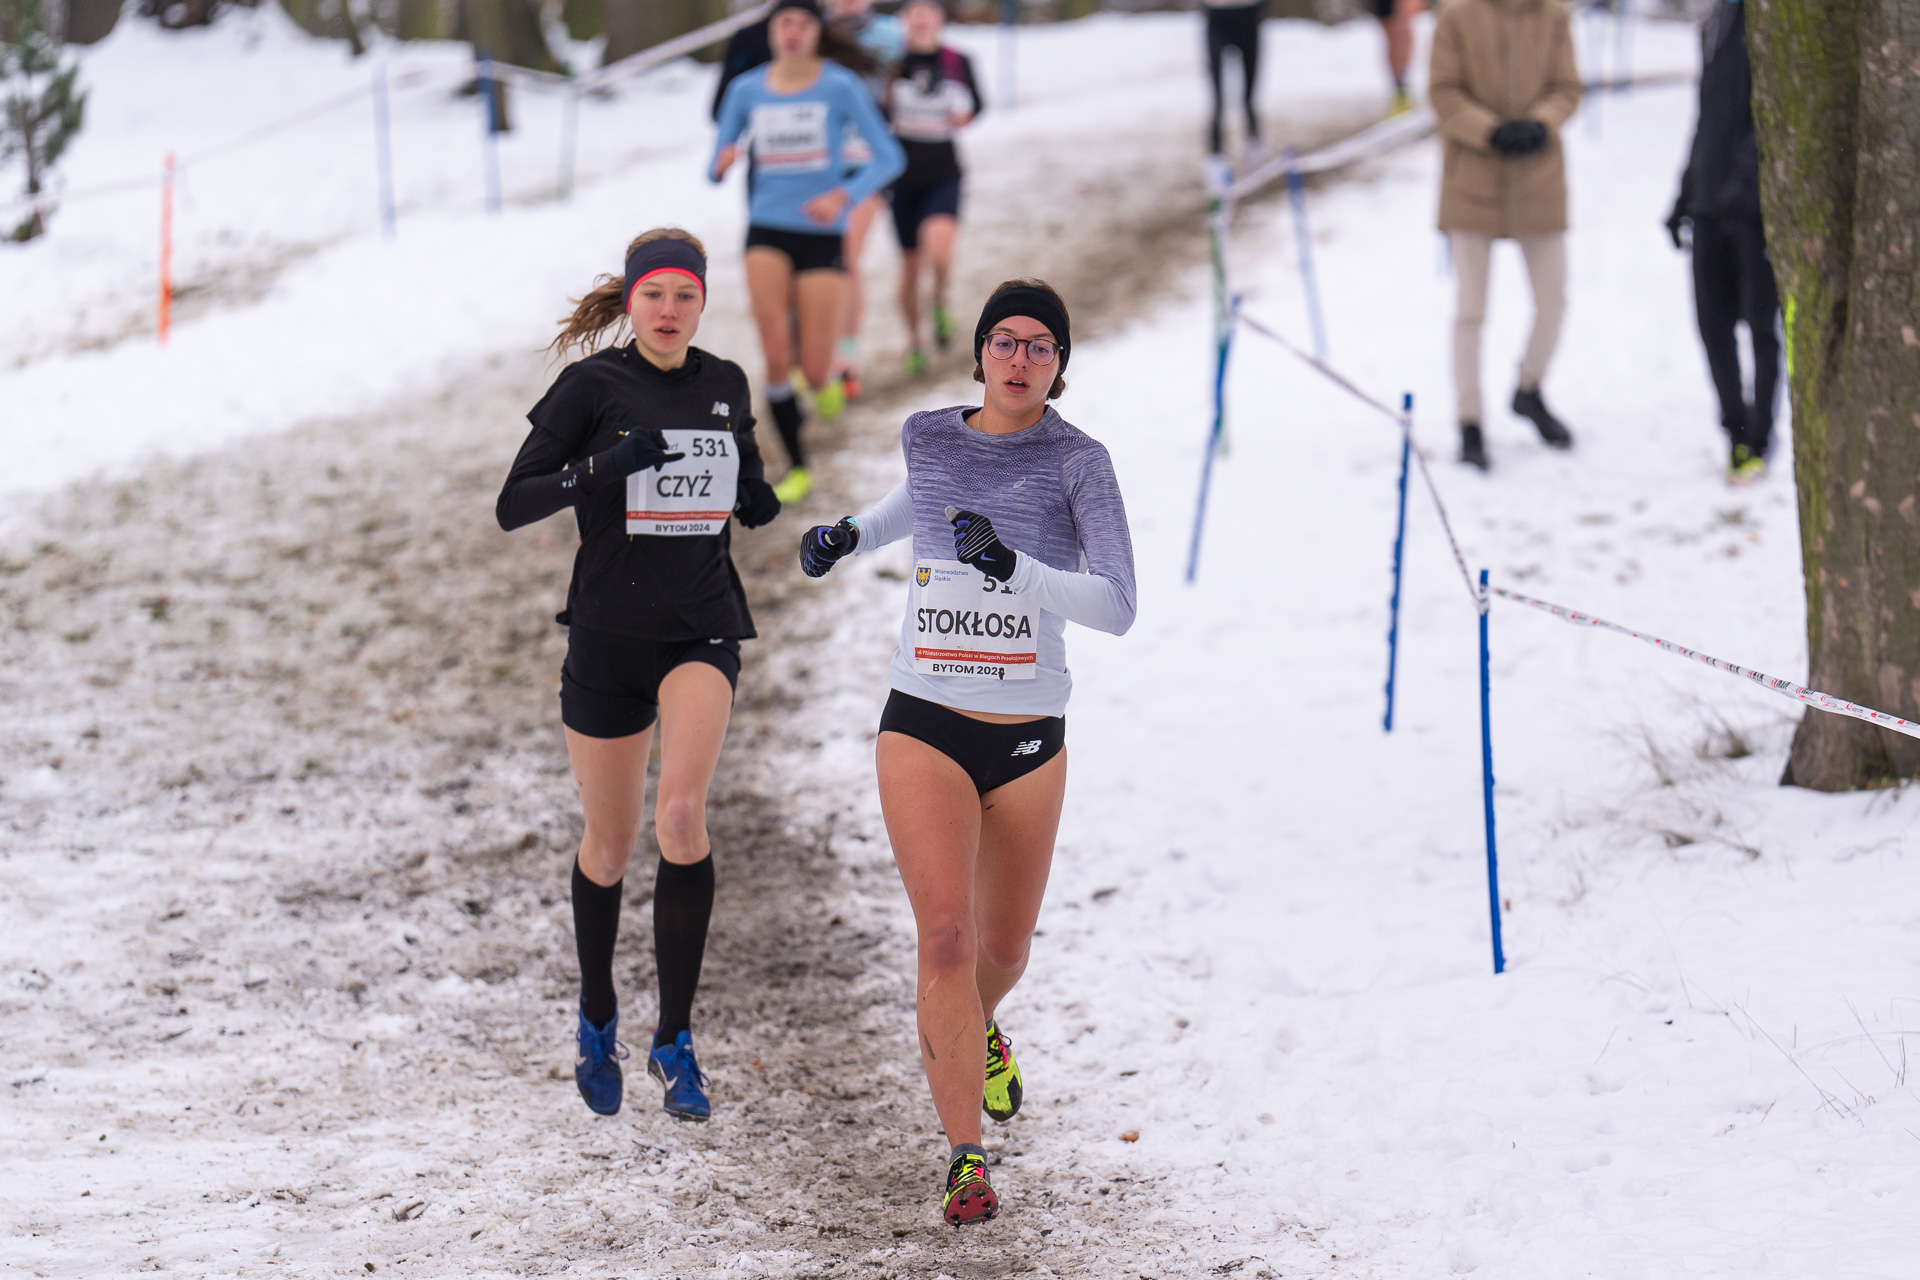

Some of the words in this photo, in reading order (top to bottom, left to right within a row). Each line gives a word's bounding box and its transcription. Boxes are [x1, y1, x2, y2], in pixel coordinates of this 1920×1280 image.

[692, 438, 729, 457] 531
[656, 469, 713, 497] CZYŻ
[655, 524, 687, 532] BYTOM
[917, 608, 1032, 639] STOKŁOSA
[932, 664, 975, 674] BYTOM
